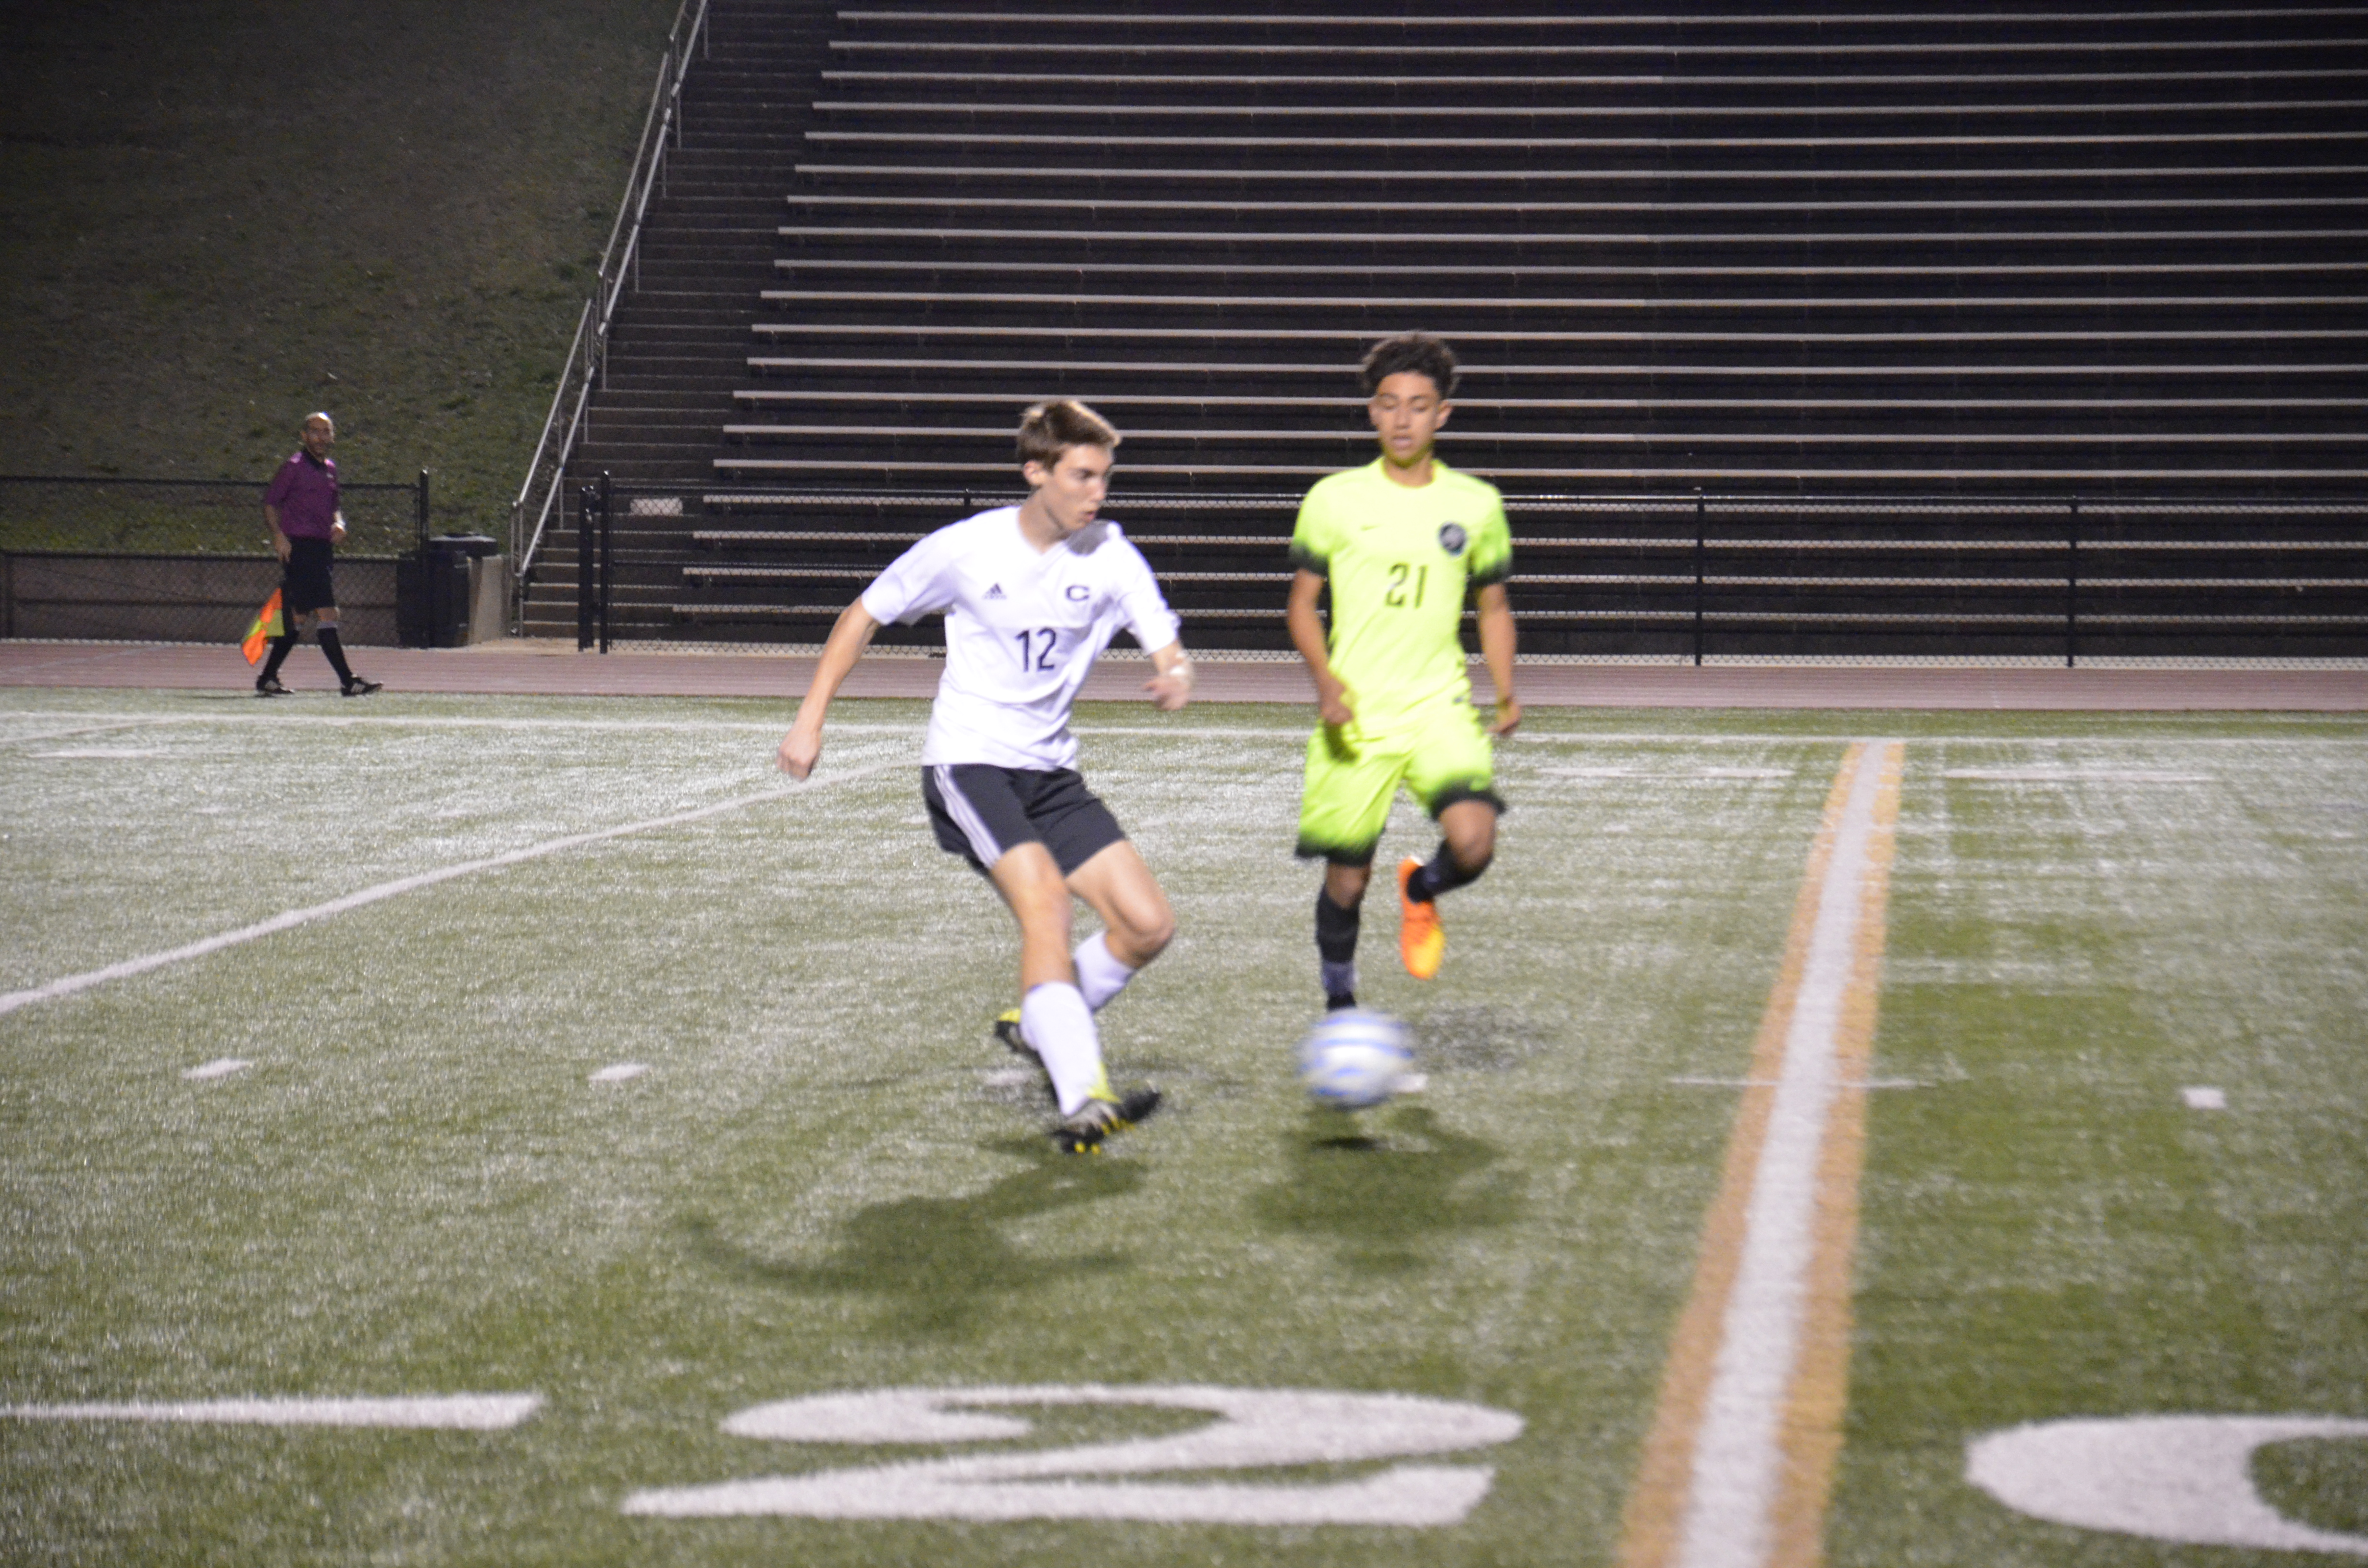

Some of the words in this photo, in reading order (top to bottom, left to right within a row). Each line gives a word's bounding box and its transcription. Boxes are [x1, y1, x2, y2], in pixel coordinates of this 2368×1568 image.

[1065, 584, 1090, 601] C
[1385, 561, 1429, 609] 21
[1014, 627, 1057, 672] 12
